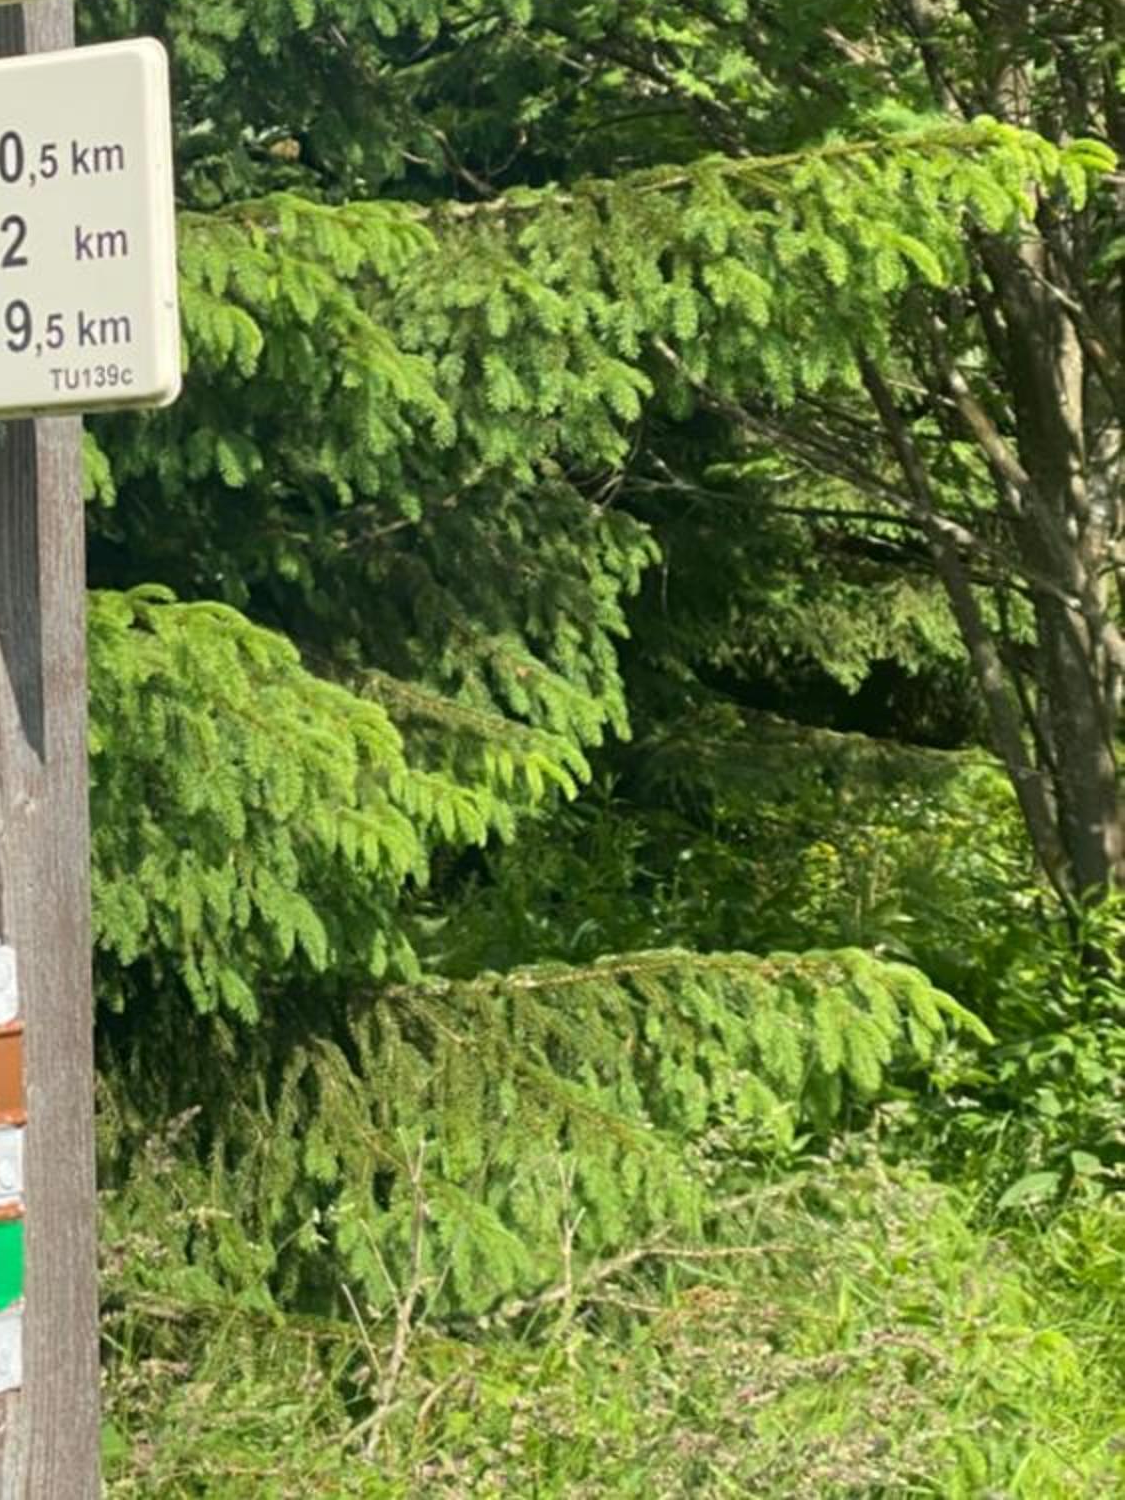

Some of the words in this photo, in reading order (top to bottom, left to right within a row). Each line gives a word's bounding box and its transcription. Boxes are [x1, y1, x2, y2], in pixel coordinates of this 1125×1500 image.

[71, 139, 124, 175] km
[0, 214, 28, 268] 2
[75, 224, 129, 261] km
[4, 298, 65, 357] 9,5
[77, 309, 131, 347] km
[50, 363, 133, 390] TU139c
